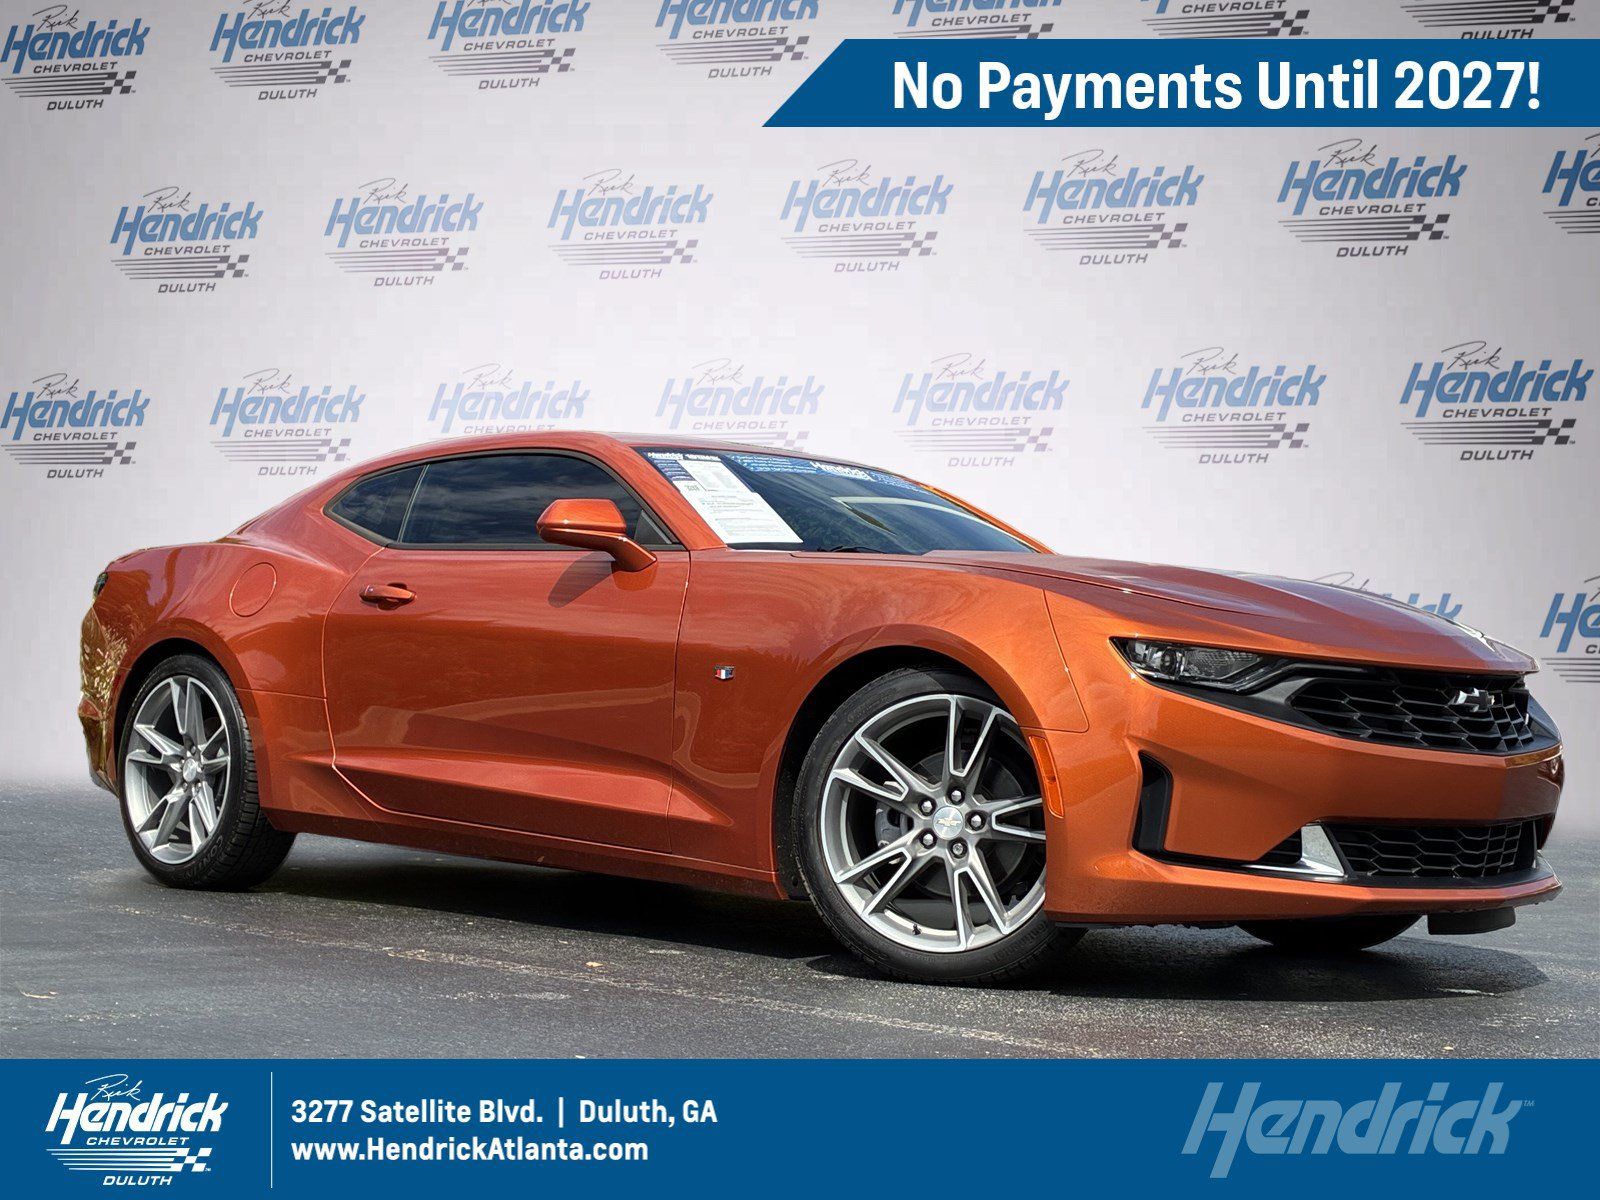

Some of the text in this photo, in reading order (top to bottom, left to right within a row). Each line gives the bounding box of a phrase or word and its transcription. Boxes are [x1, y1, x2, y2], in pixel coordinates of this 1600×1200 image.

[1182, 0, 1286, 13] CHEVROLET
[427, 0, 590, 51] Hendrick
[932, 13, 1031, 26] CHEVROLET
[209, 6, 366, 63] Hendrick
[693, 26, 788, 39] CHEVROLET
[1, 18, 150, 74] Hendrick
[464, 39, 555, 51] CHEVROLET
[244, 51, 332, 62] CHEVROLET
[34, 62, 118, 74] CHEVROLET
[708, 66, 772, 78] DULUTH
[478, 78, 540, 89] DULUTH
[258, 89, 317, 100] DULUTH
[47, 99, 104, 110] DULUTH
[1277, 154, 1468, 216] Hendrick
[1023, 164, 1204, 224] Hendrick
[779, 174, 955, 233] Hendrick
[1319, 203, 1427, 217] CHEVROLET
[547, 184, 715, 241] Hendrick
[1063, 212, 1166, 225] CHEVROLET
[324, 192, 484, 248] Hendrick
[818, 220, 917, 233] CHEVROLET
[110, 201, 264, 256] Hendrick
[583, 229, 679, 241] CHEVROLET
[359, 237, 450, 248] CHEVROLET
[143, 244, 232, 256] CHEVROLET
[1337, 245, 1409, 258] DULUTH
[1079, 252, 1149, 265] DULUTH
[834, 260, 901, 273] DULUTH
[598, 267, 663, 280] DULUTH
[158, 281, 217, 293] DULUTH
[373, 275, 435, 287] DULUTH
[1141, 364, 1327, 422] Hendrick
[1400, 359, 1594, 418] Hendrick
[655, 375, 825, 429] Hendrick
[892, 369, 1070, 426] Hendrick
[209, 384, 366, 437] Hendrick
[427, 380, 590, 433] Hendrick
[1443, 407, 1552, 418] CHEVROLET
[0, 389, 150, 440] Hendrick
[1181, 412, 1287, 423] CHEVROLET
[692, 420, 788, 430] CHEVROLET
[931, 416, 1031, 427] CHEVROLET
[33, 430, 118, 442] CHEVROLET
[244, 427, 333, 438] CHEVROLET
[947, 456, 1015, 467] DULUTH
[1198, 453, 1270, 464] DULUTH
[1460, 450, 1534, 461] DULUTH
[46, 467, 104, 479] DULUTH
[258, 465, 318, 477] DULUTH
